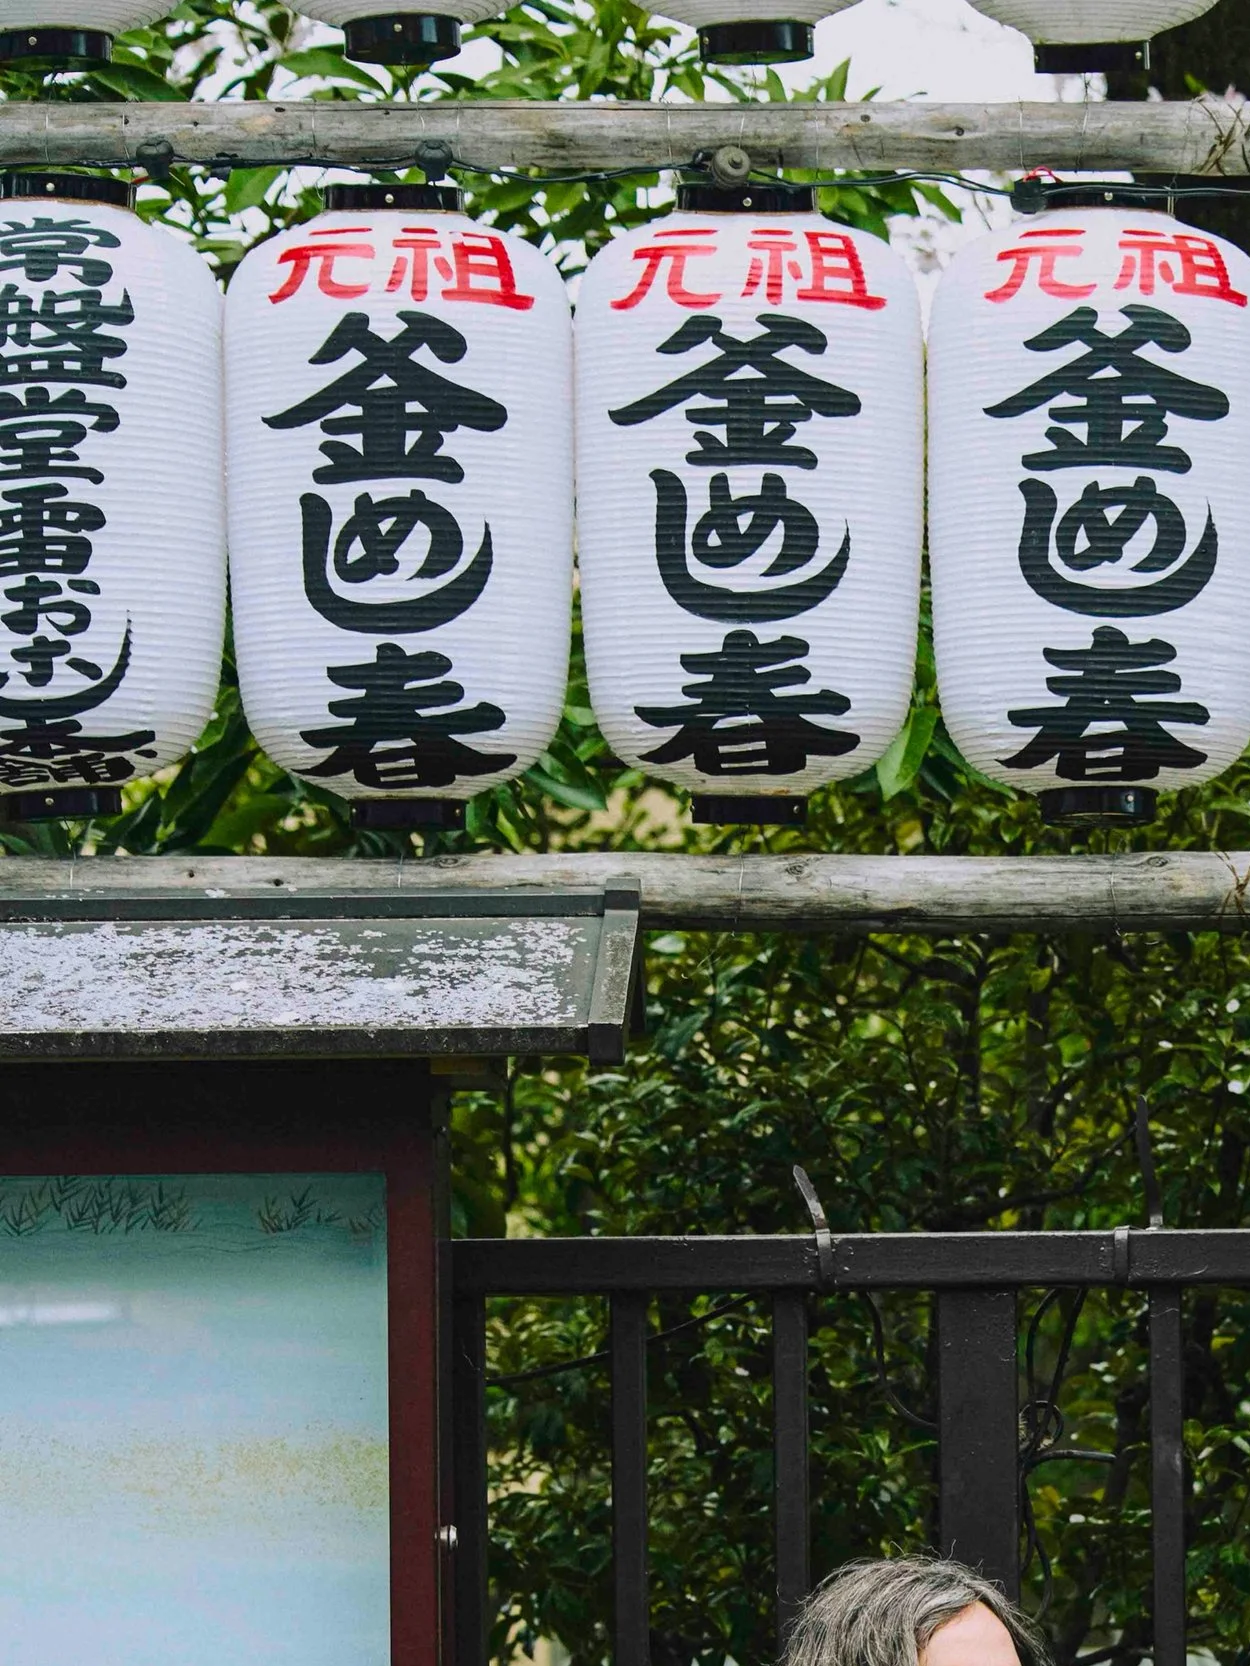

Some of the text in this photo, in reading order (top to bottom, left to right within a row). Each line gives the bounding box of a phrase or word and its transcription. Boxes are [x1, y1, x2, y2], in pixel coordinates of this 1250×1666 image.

[269, 227, 535, 311] 元祖
[610, 227, 887, 311] 元祖
[984, 227, 1248, 308] 元祖
[262, 310, 517, 789] 釜めし春
[608, 314, 862, 777] 釜めし春
[984, 304, 1229, 782] 釜めし春
